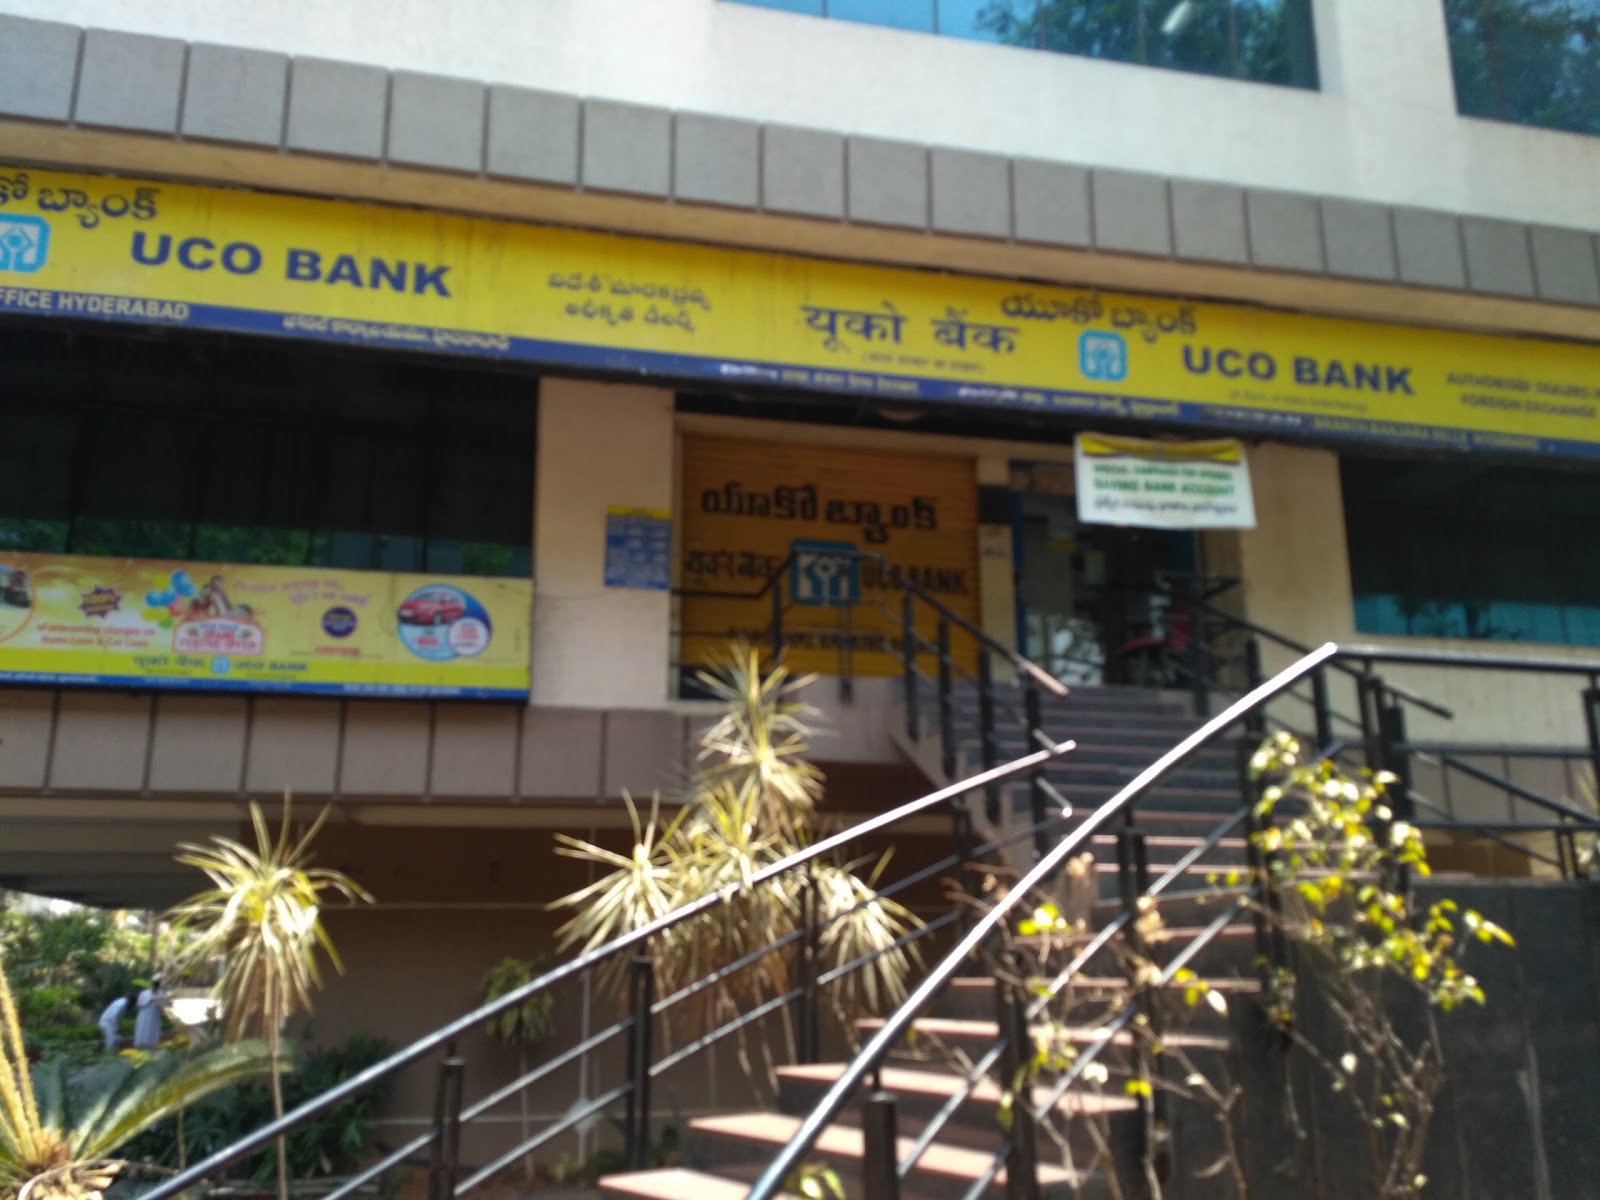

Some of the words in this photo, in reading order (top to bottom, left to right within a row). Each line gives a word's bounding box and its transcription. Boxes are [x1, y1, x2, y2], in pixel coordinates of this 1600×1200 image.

[37, 186, 160, 229] బ్యాంక్
[131, 231, 262, 276] UCO
[285, 247, 452, 298] BANK
[58, 292, 190, 321] HYDERABAD
[800, 301, 908, 353] यूको
[931, 306, 1020, 354] बैंक
[1000, 294, 1104, 325] యూకో
[1111, 304, 1198, 344] బ్యాంక్
[1183, 345, 1276, 382] UCO
[1294, 357, 1416, 396] BANK
[1144, 480, 1176, 494] BANK
